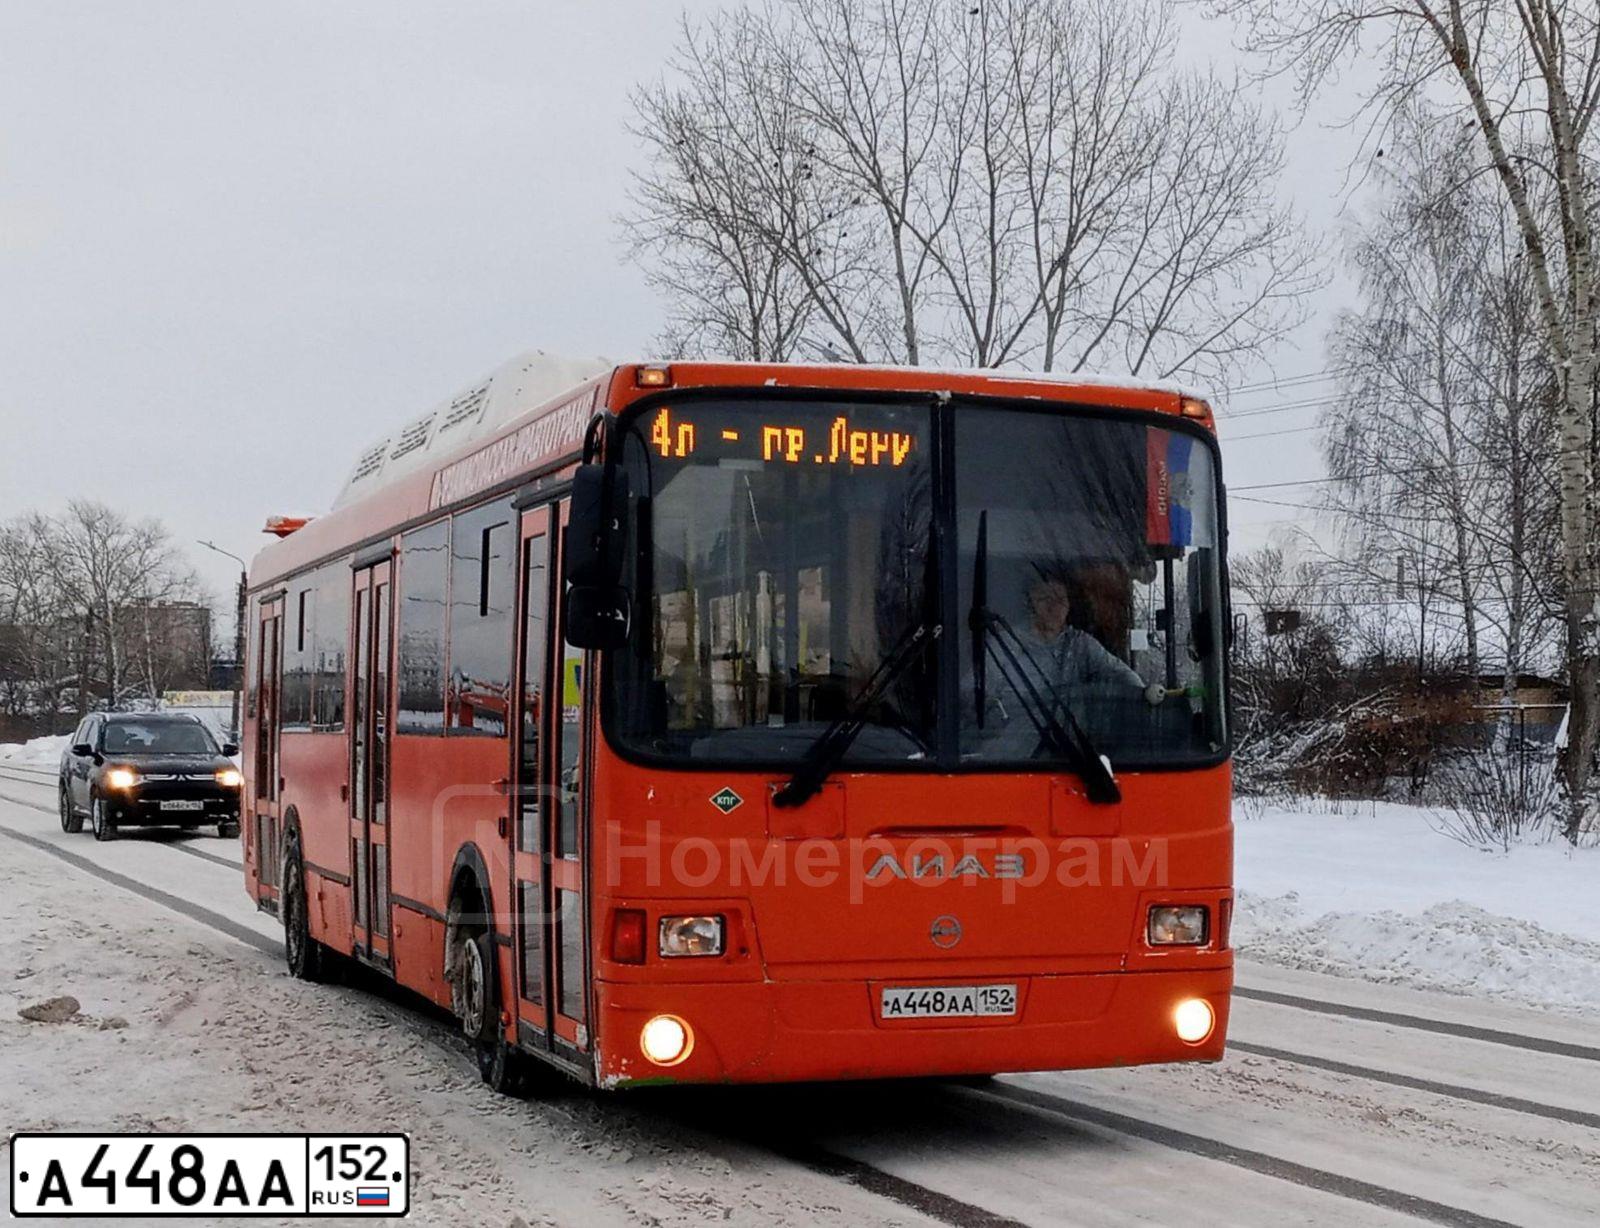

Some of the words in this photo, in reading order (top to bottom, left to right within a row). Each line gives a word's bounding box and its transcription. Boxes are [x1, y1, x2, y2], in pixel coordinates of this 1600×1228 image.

[866, 854, 1024, 879] ЛИАЗ
[890, 991, 974, 1014] А448АА
[979, 989, 1010, 1006] 152
